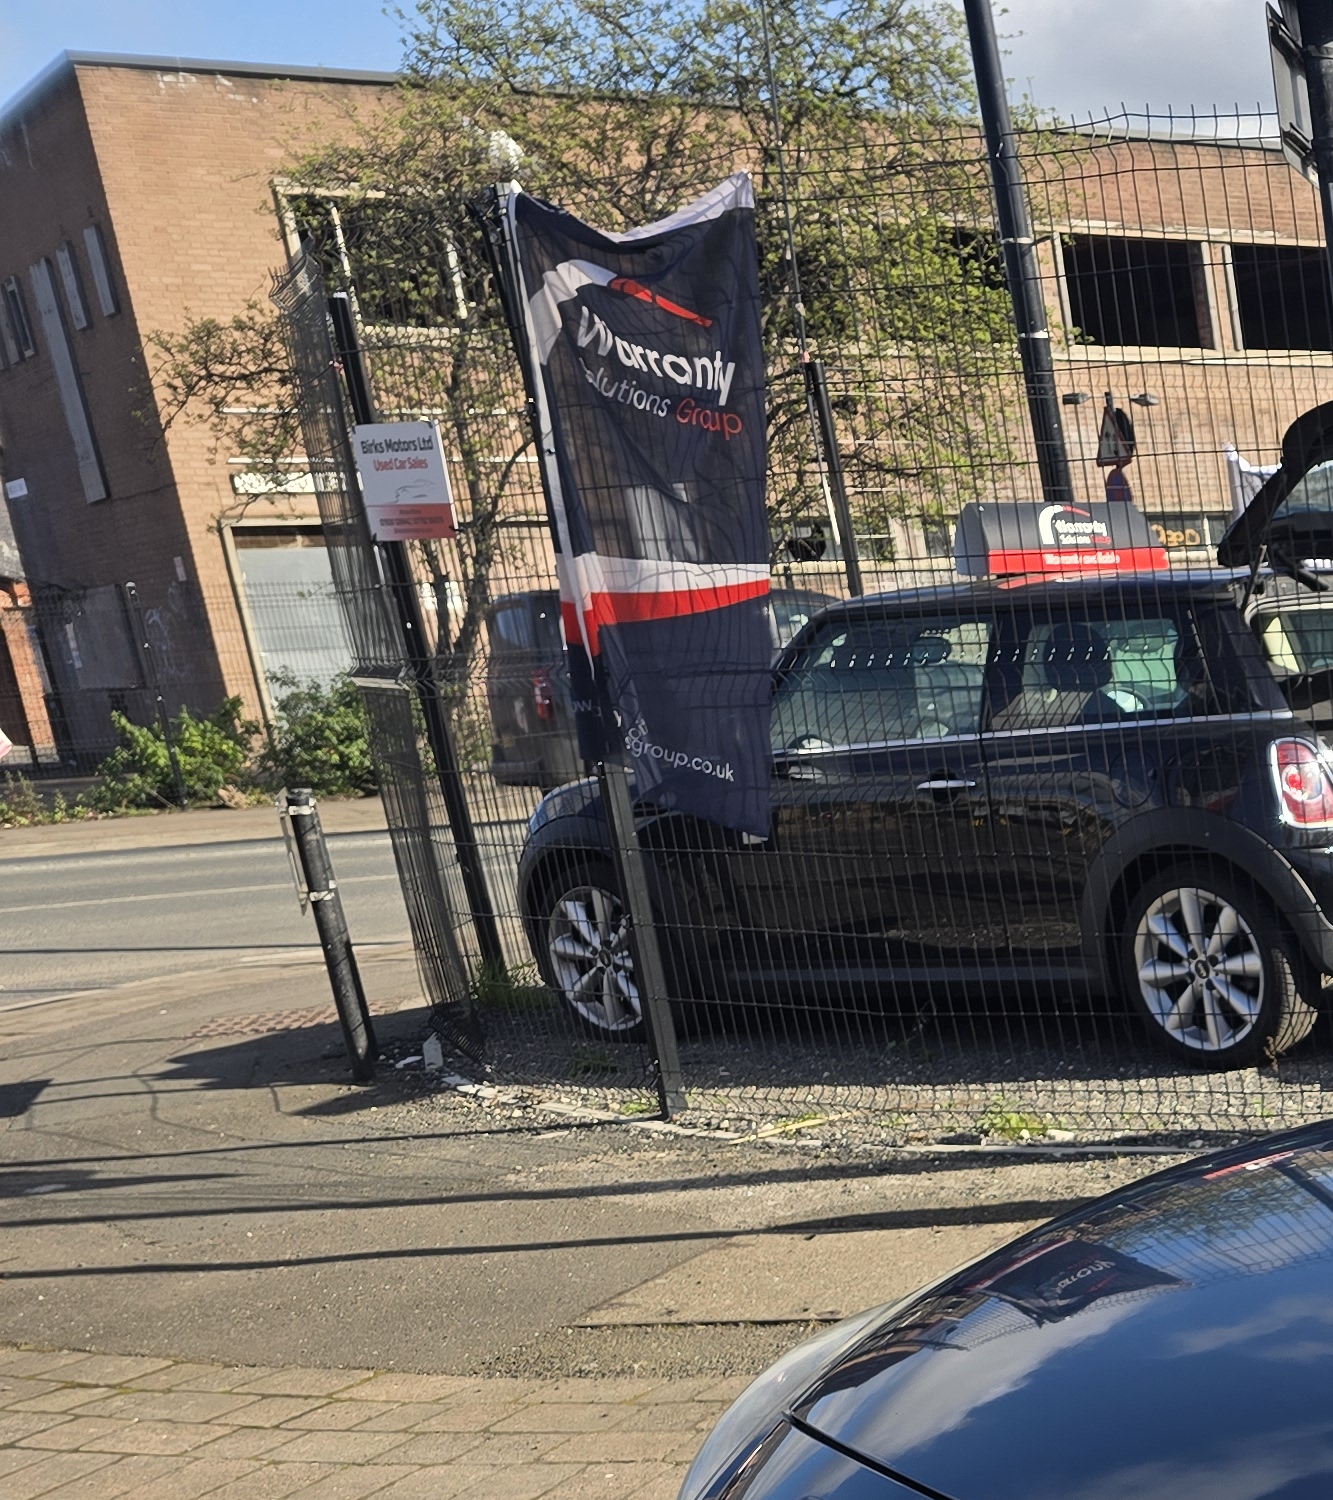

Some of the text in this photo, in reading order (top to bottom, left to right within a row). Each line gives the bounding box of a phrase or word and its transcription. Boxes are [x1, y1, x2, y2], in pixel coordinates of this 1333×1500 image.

[577, 306, 736, 406] Warranty
[579, 357, 742, 440] lutions Group
[361, 436, 434, 454] Birks Motors Ltd
[373, 456, 428, 471] Used Car Sales
